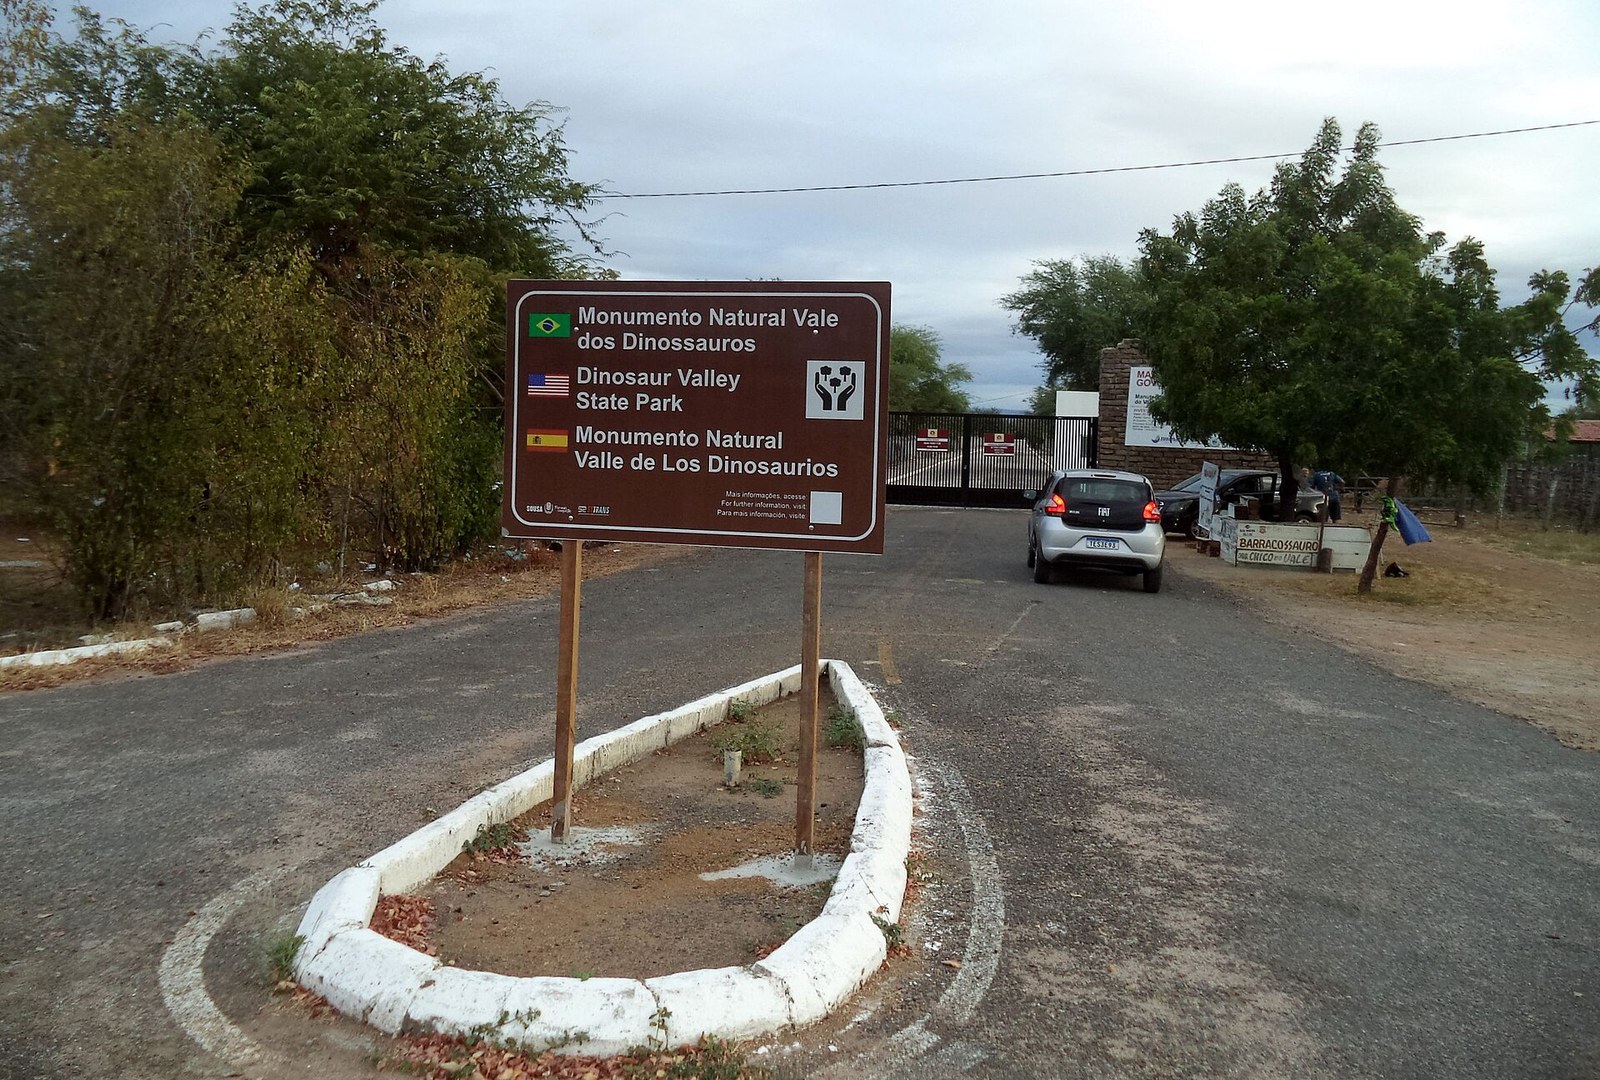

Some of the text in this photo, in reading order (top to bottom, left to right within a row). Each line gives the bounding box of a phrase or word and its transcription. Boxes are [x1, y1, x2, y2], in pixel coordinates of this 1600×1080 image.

[578, 306, 839, 327] Monumento Natural Vale
[577, 331, 756, 352] dos Dinossauros
[577, 366, 741, 392] Dinosaur Valley
[576, 391, 683, 412] State Park
[575, 425, 783, 449] Monumento Natural
[574, 450, 839, 477] Valle de Los Dinosaurios
[725, 490, 740, 498] Mais
[733, 500, 755, 508] further
[1098, 507, 1111, 516] FIAT
[1240, 538, 1319, 552] BARRACOSSAURO
[1249, 551, 1274, 561] CHICO
[1284, 553, 1310, 564] VALE
